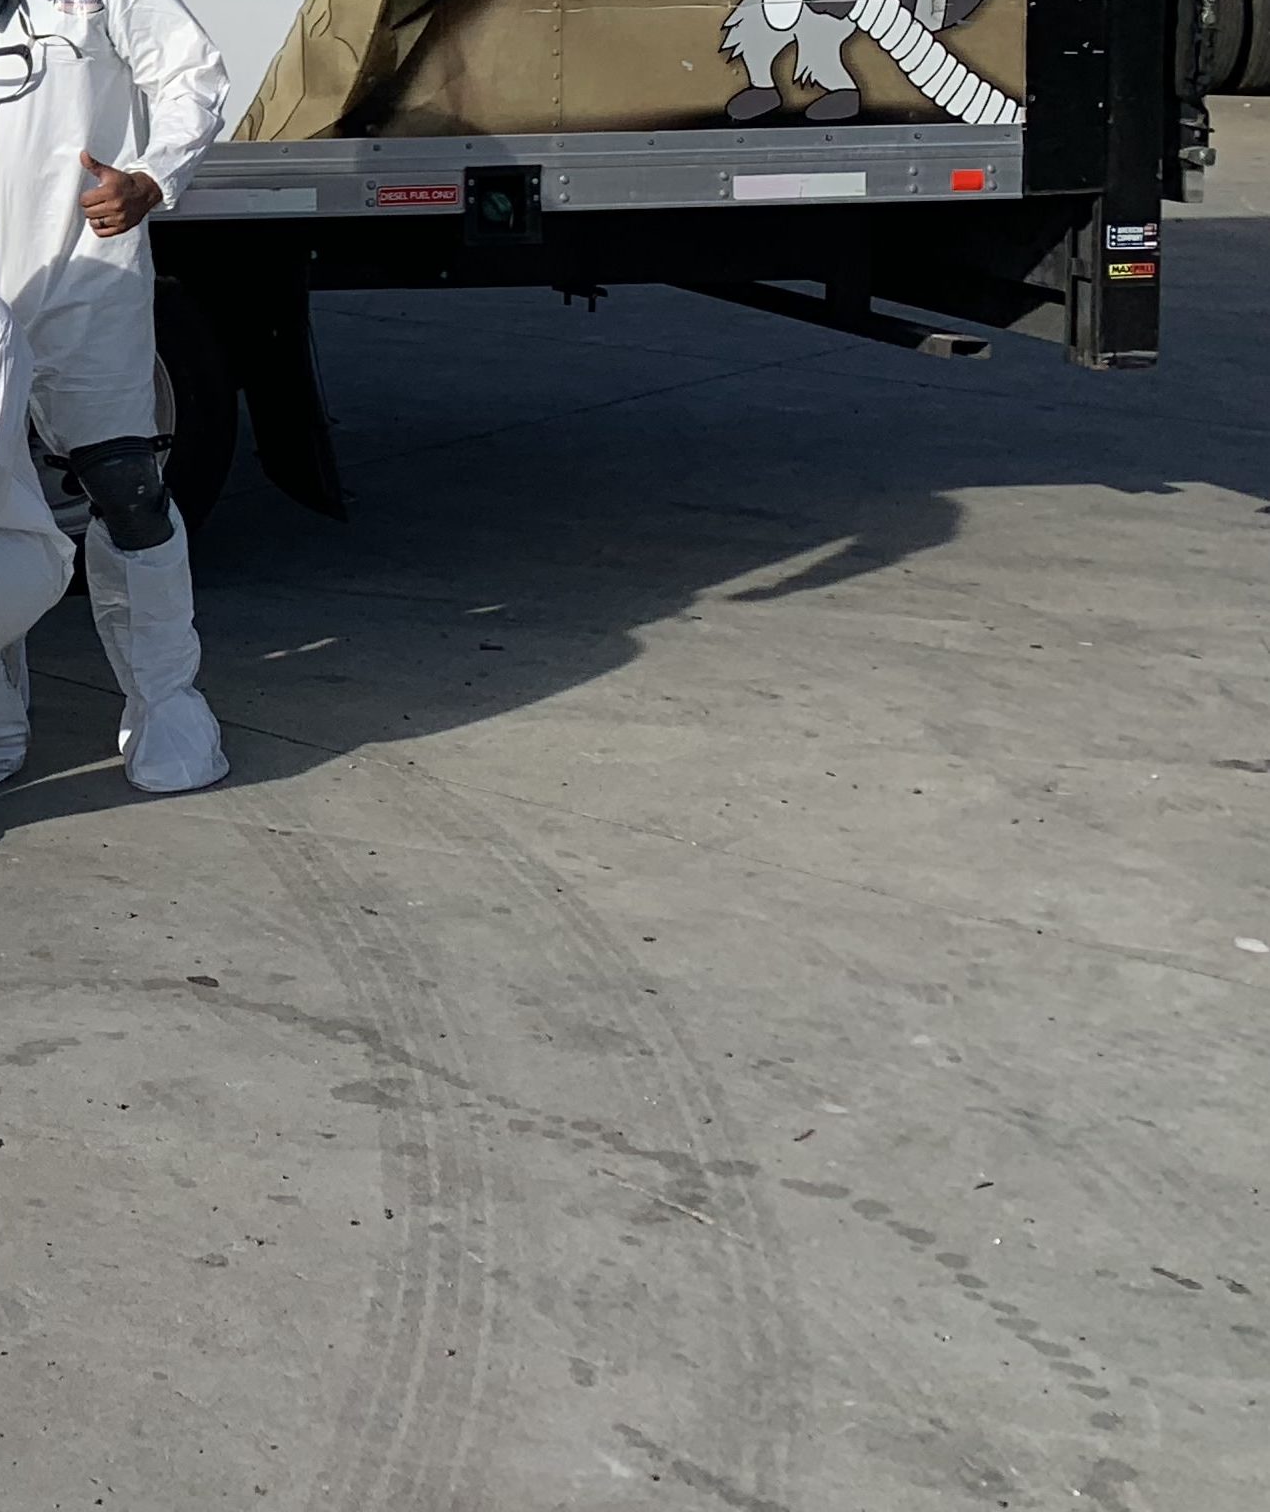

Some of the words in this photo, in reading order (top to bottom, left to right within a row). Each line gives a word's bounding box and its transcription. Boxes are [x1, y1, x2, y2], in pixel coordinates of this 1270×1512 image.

[380, 191, 408, 201] DIESEL
[409, 191, 430, 200] FUEL
[431, 190, 455, 199] ONLY
